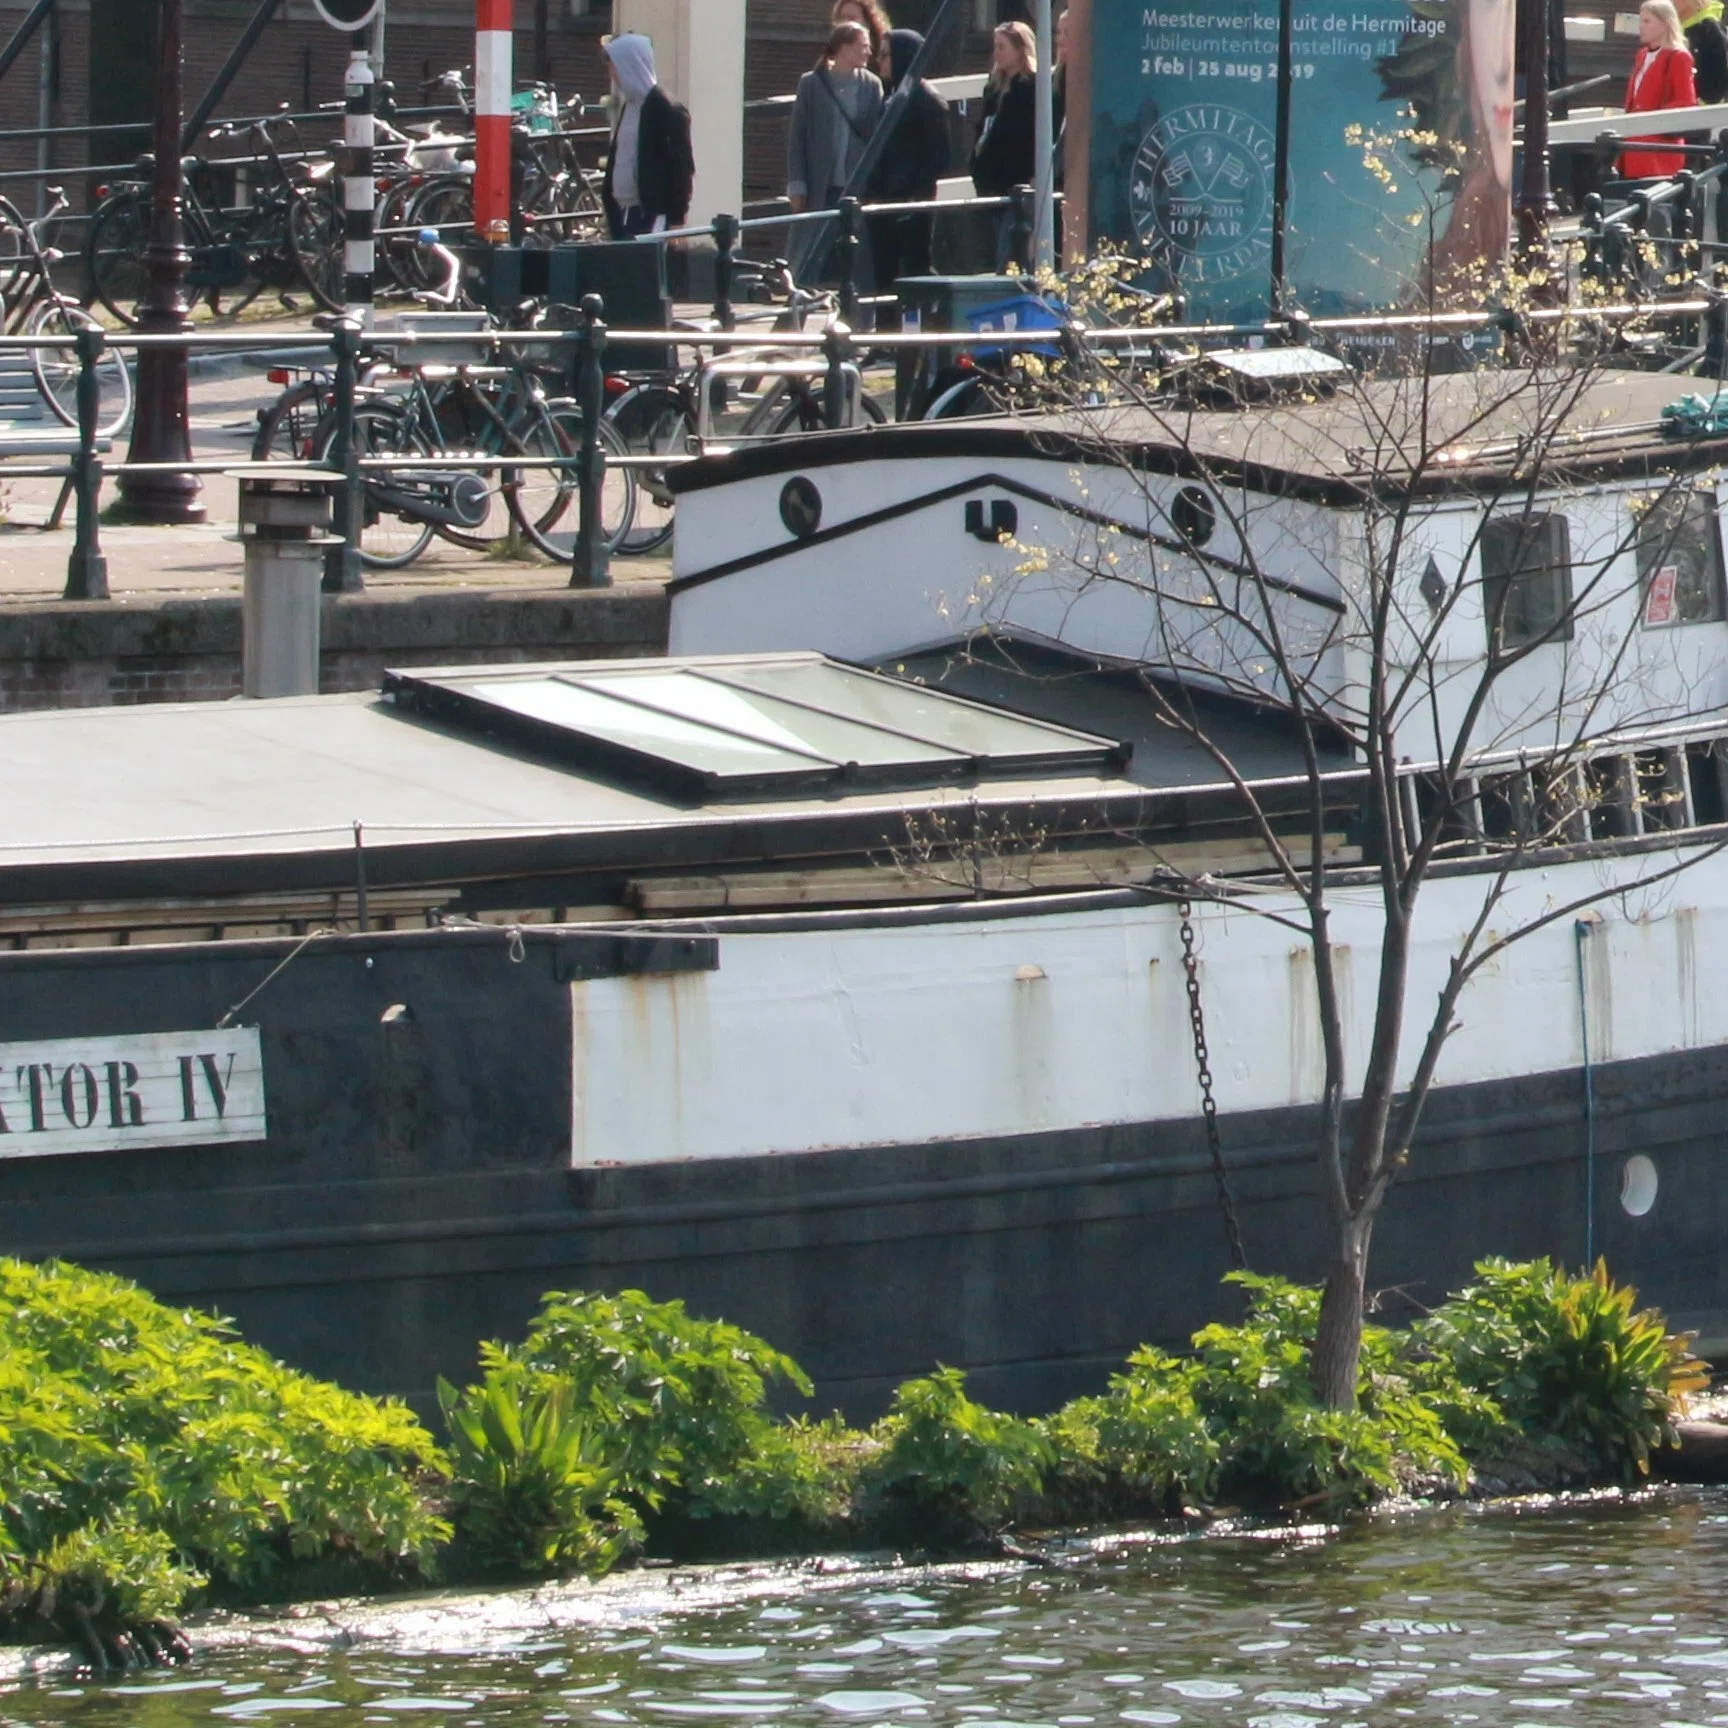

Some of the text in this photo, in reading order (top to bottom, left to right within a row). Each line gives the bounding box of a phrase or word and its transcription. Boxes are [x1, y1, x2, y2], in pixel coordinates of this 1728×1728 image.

[1293, 14, 1317, 32] uit
[1323, 14, 1347, 32] de
[1352, 14, 1446, 38] Hermitage
[1376, 39, 1398, 56] #1
[1142, 60, 1150, 74] 2
[1154, 57, 1184, 75] feb
[1199, 62, 1219, 76] 25
[1225, 63, 1262, 82] aug
[1268, 63, 1315, 79] 219
[1169, 219, 1242, 238] 10 JAAR
[0, 1052, 237, 1133] TOR IV
